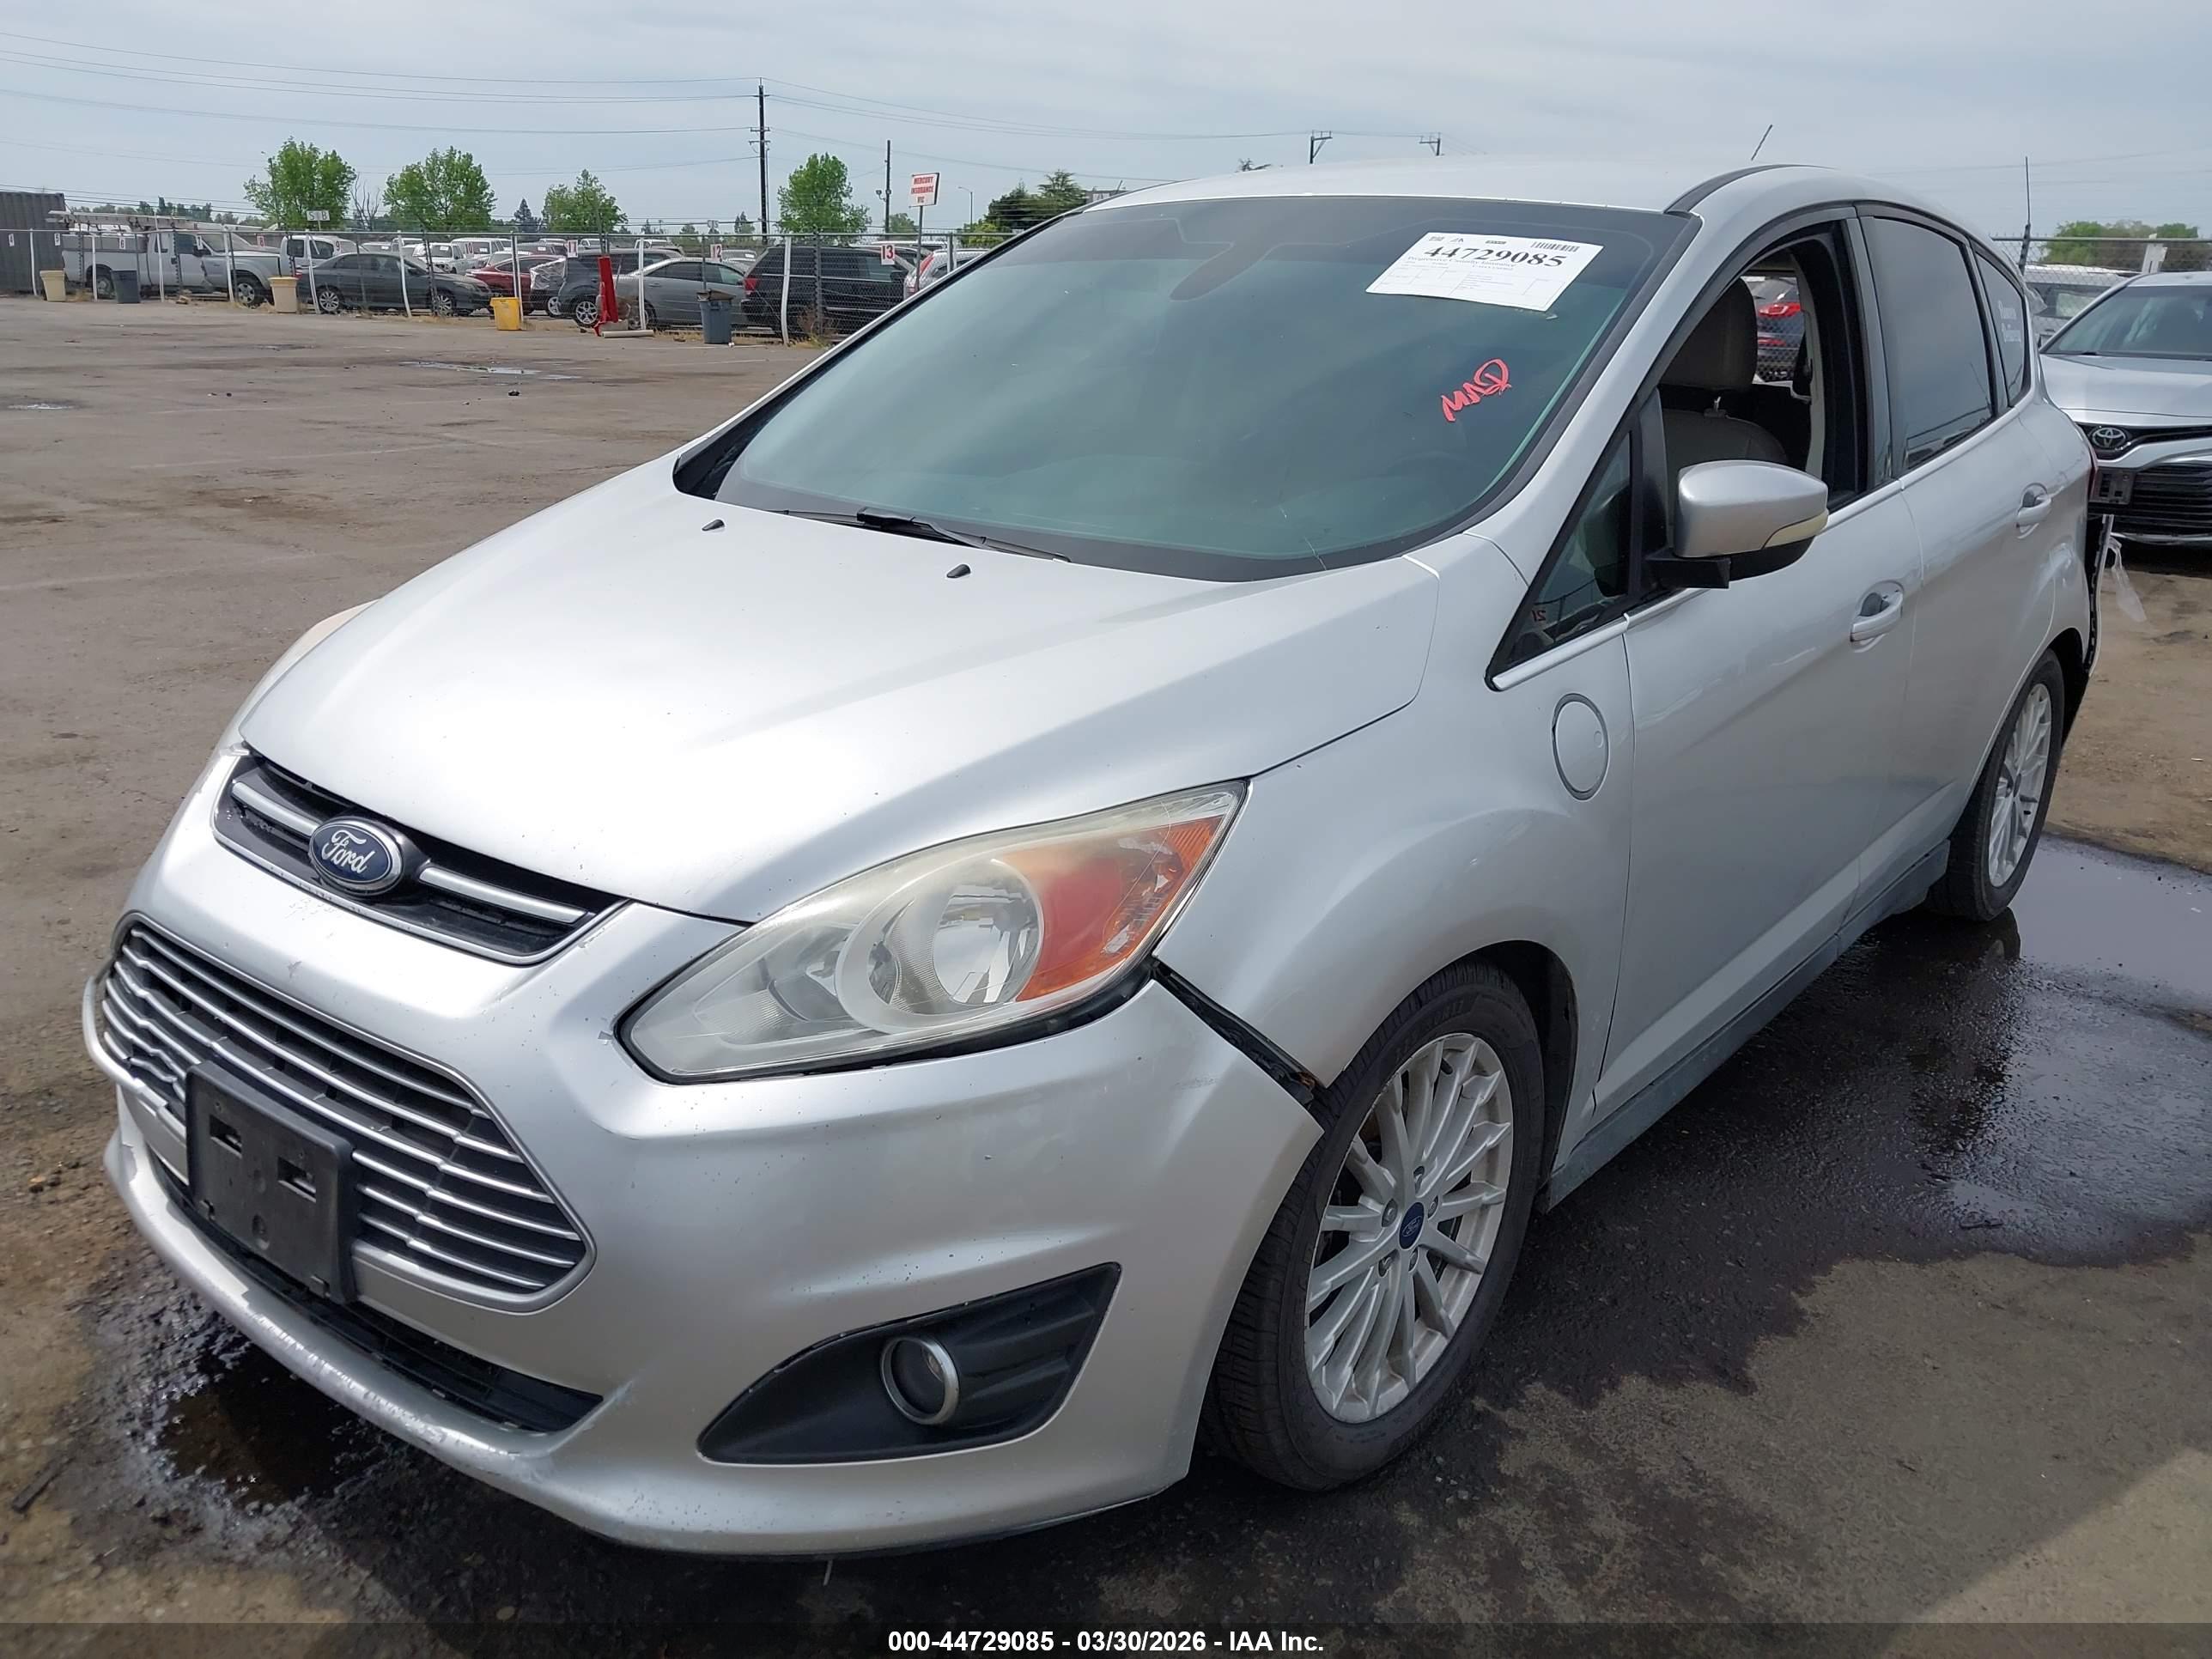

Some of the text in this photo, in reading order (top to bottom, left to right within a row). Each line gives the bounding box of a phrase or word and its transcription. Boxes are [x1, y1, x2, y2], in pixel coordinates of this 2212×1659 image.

[713, 245, 721, 258] 12
[882, 245, 894, 259] 13
[1424, 246, 1567, 267] 44729085
[321, 830, 375, 874] Ford
